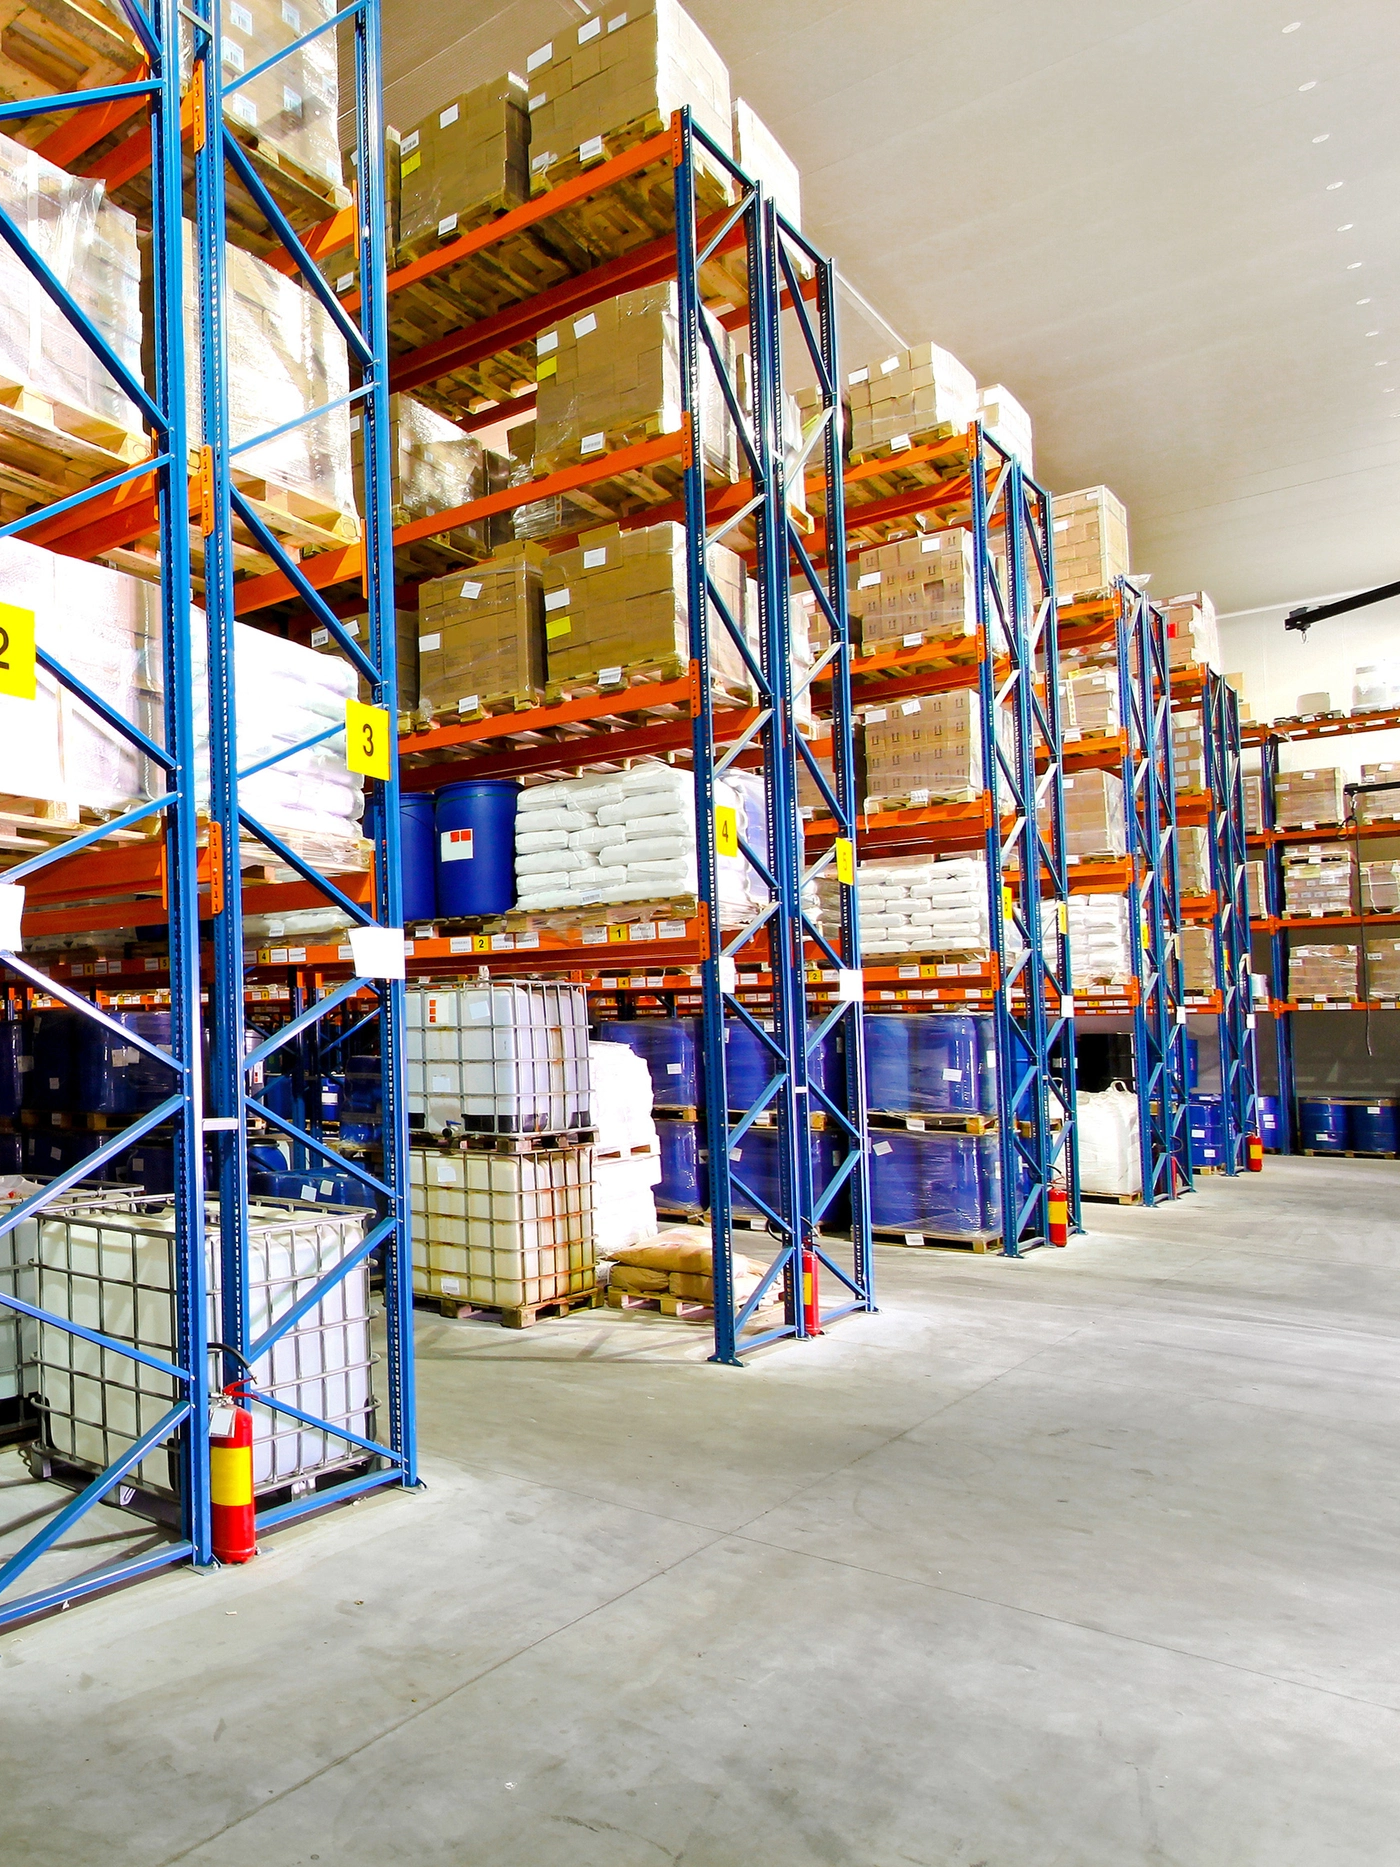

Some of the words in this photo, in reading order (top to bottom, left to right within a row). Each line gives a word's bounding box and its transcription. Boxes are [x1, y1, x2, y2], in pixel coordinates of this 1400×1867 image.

[362, 724, 375, 757] 3
[721, 820, 729, 843] 4
[842, 852, 848, 872] 5
[616, 929, 622, 938] 1
[478, 939, 484, 948] 2
[261, 952, 267, 961] 4
[162, 959, 167, 967] 5
